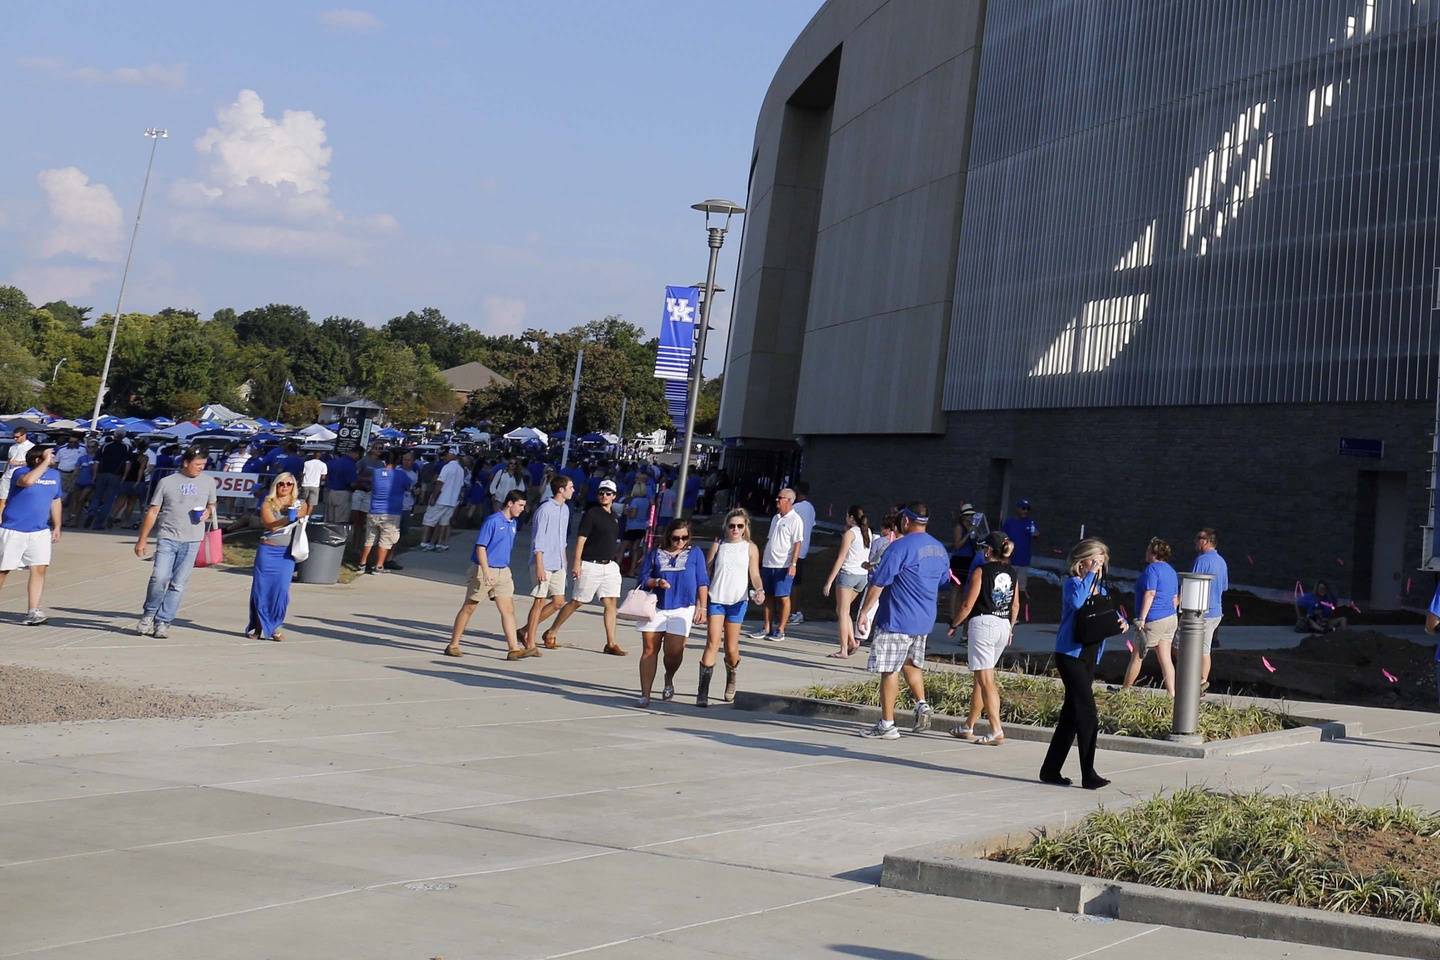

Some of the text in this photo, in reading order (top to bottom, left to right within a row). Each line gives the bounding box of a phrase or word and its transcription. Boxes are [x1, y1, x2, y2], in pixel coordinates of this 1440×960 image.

[666, 297, 694, 323] UK
[181, 483, 198, 496] UK
[213, 476, 256, 492] OSED
